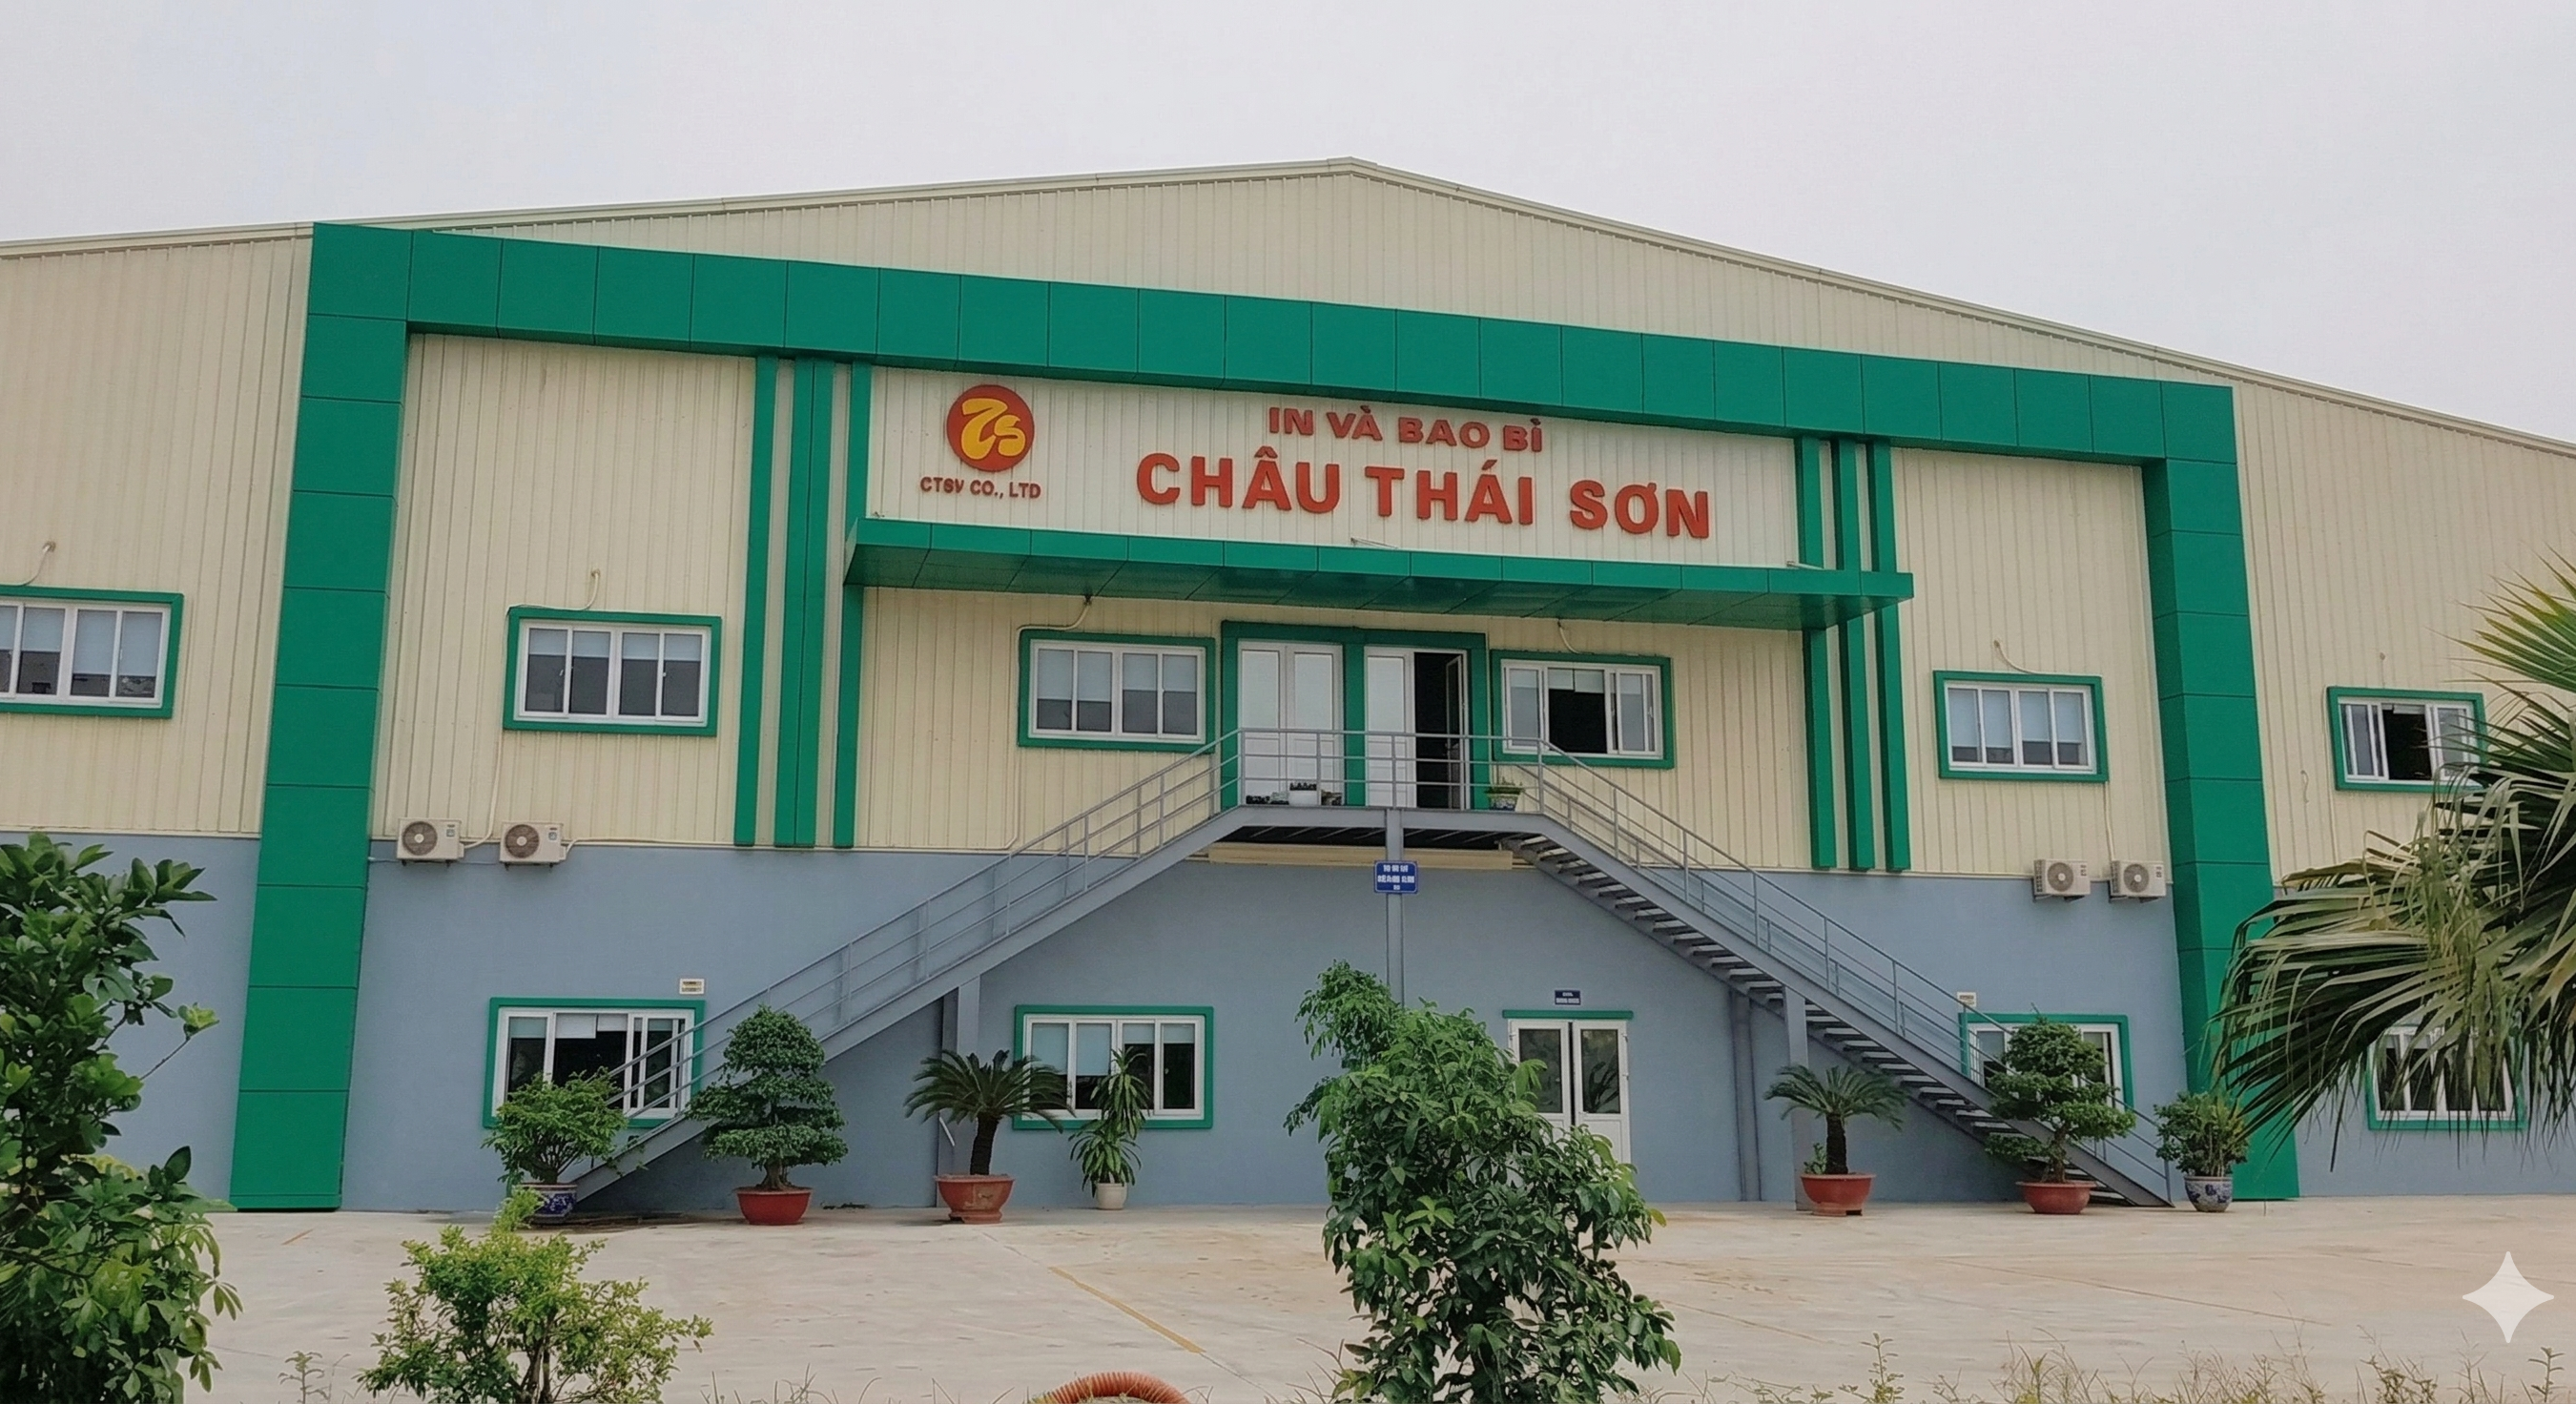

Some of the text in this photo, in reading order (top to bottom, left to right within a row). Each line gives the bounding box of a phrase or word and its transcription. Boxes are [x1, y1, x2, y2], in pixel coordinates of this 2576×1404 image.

[1269, 404, 1542, 452] IN VÀ BAO BÌ
[919, 476, 964, 494] CTSV
[1008, 481, 1042, 500] LTD
[1136, 445, 1712, 540] CHÂU THÁI SƠN
